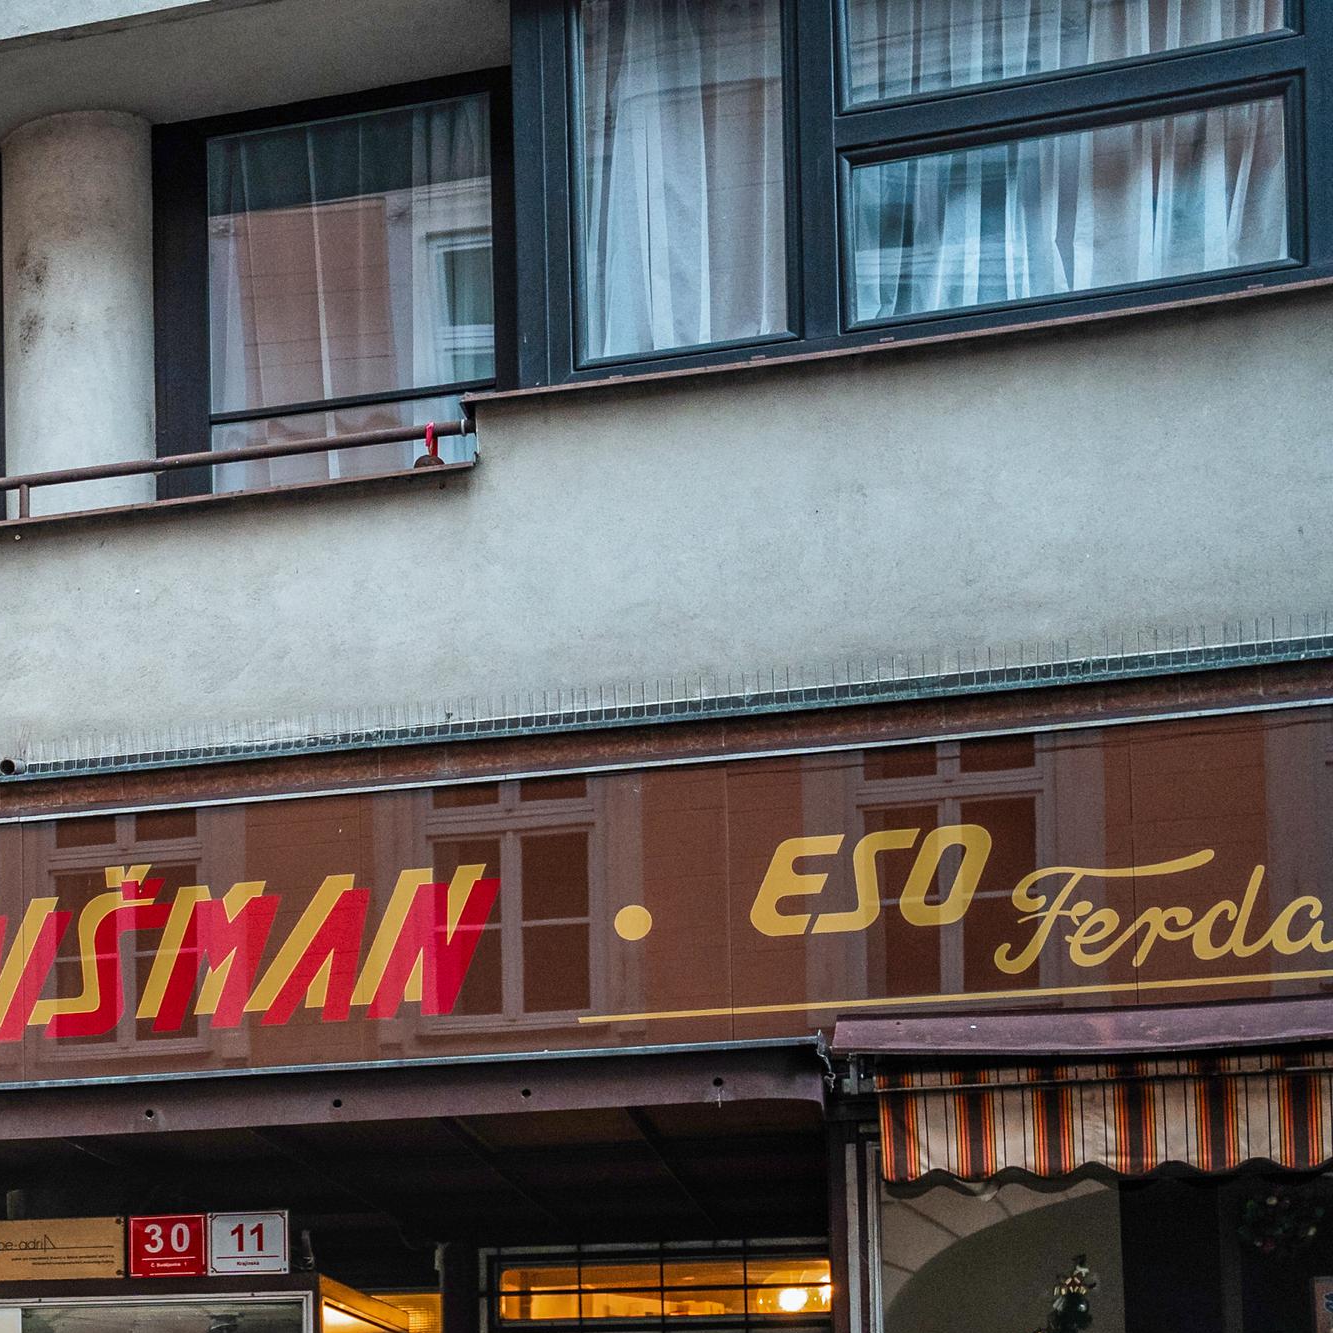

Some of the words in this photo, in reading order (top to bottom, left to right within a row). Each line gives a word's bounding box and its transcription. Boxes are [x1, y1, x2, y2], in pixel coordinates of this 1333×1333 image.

[749, 823, 993, 937] ESO
[143, 1222, 191, 1254] 30
[230, 1222, 265, 1252] 11
